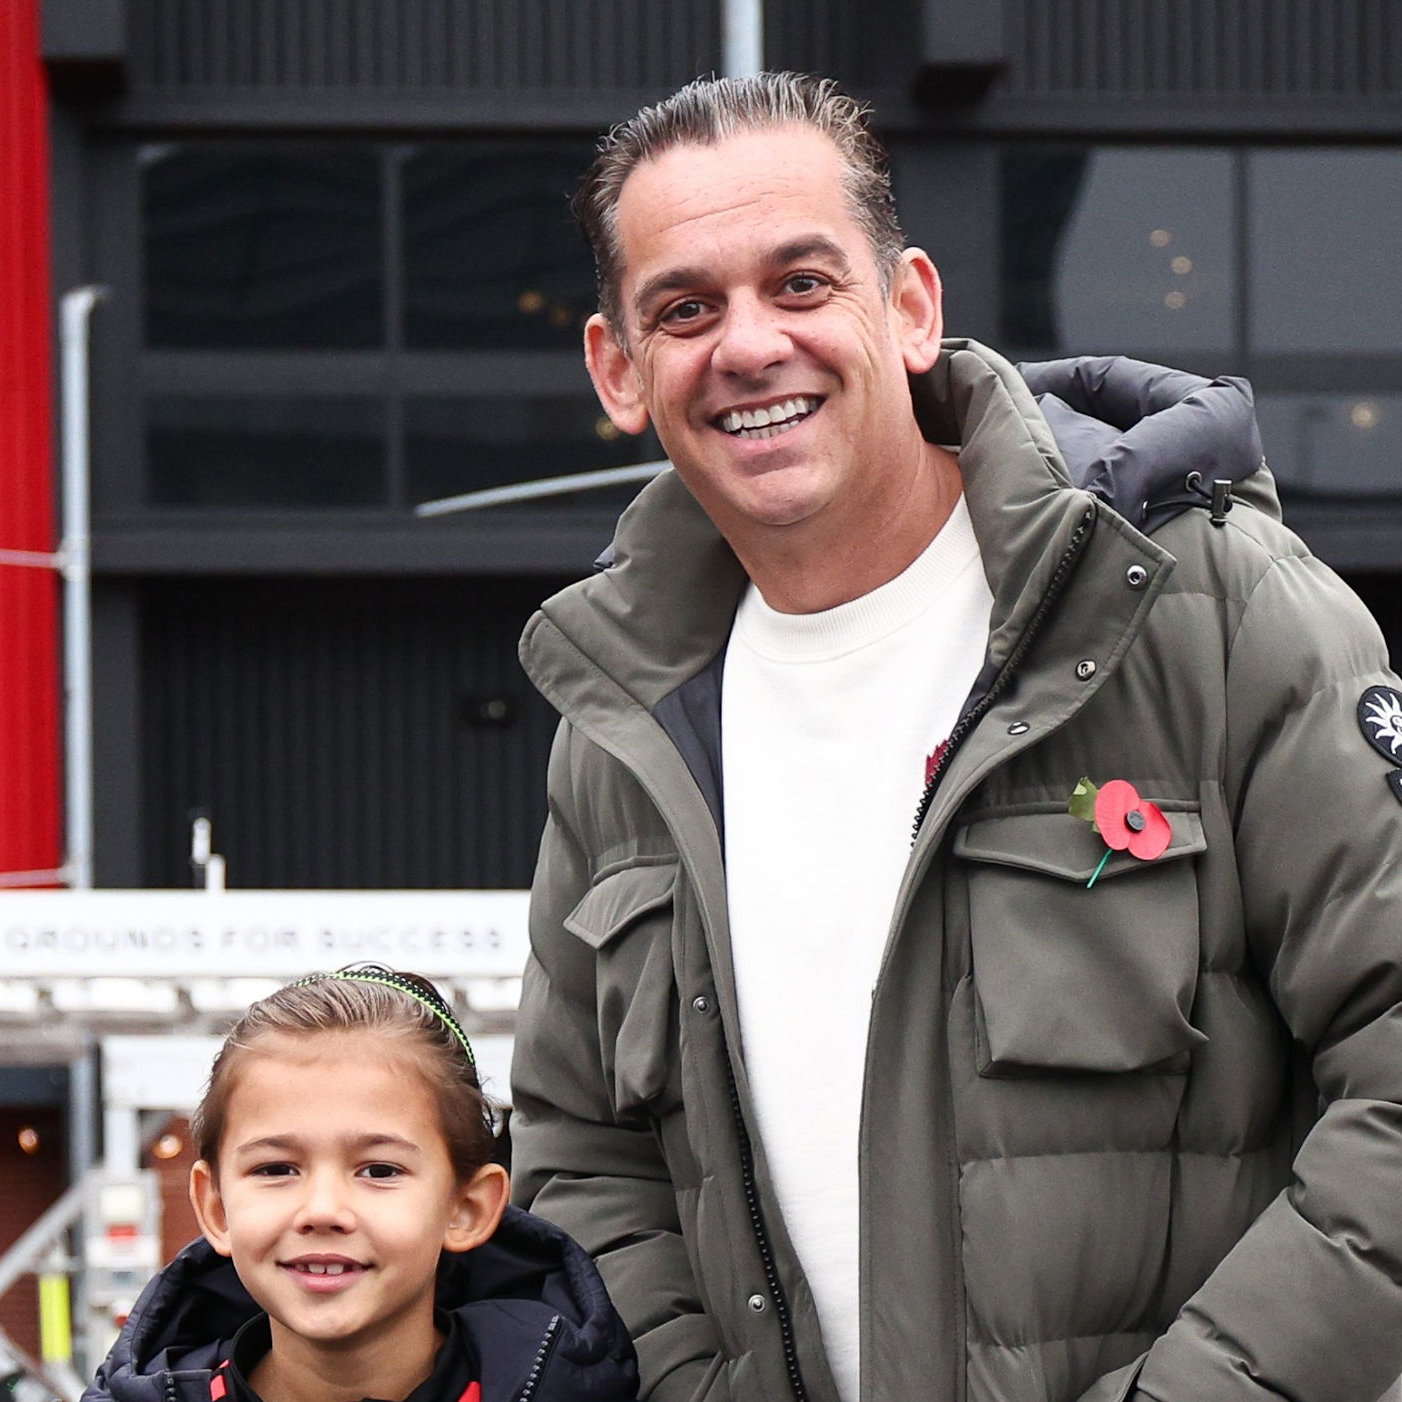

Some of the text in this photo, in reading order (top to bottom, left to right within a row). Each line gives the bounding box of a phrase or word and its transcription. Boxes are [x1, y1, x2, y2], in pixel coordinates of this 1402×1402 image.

[4, 924, 506, 955] GROUNDS FOR SUCCESS
